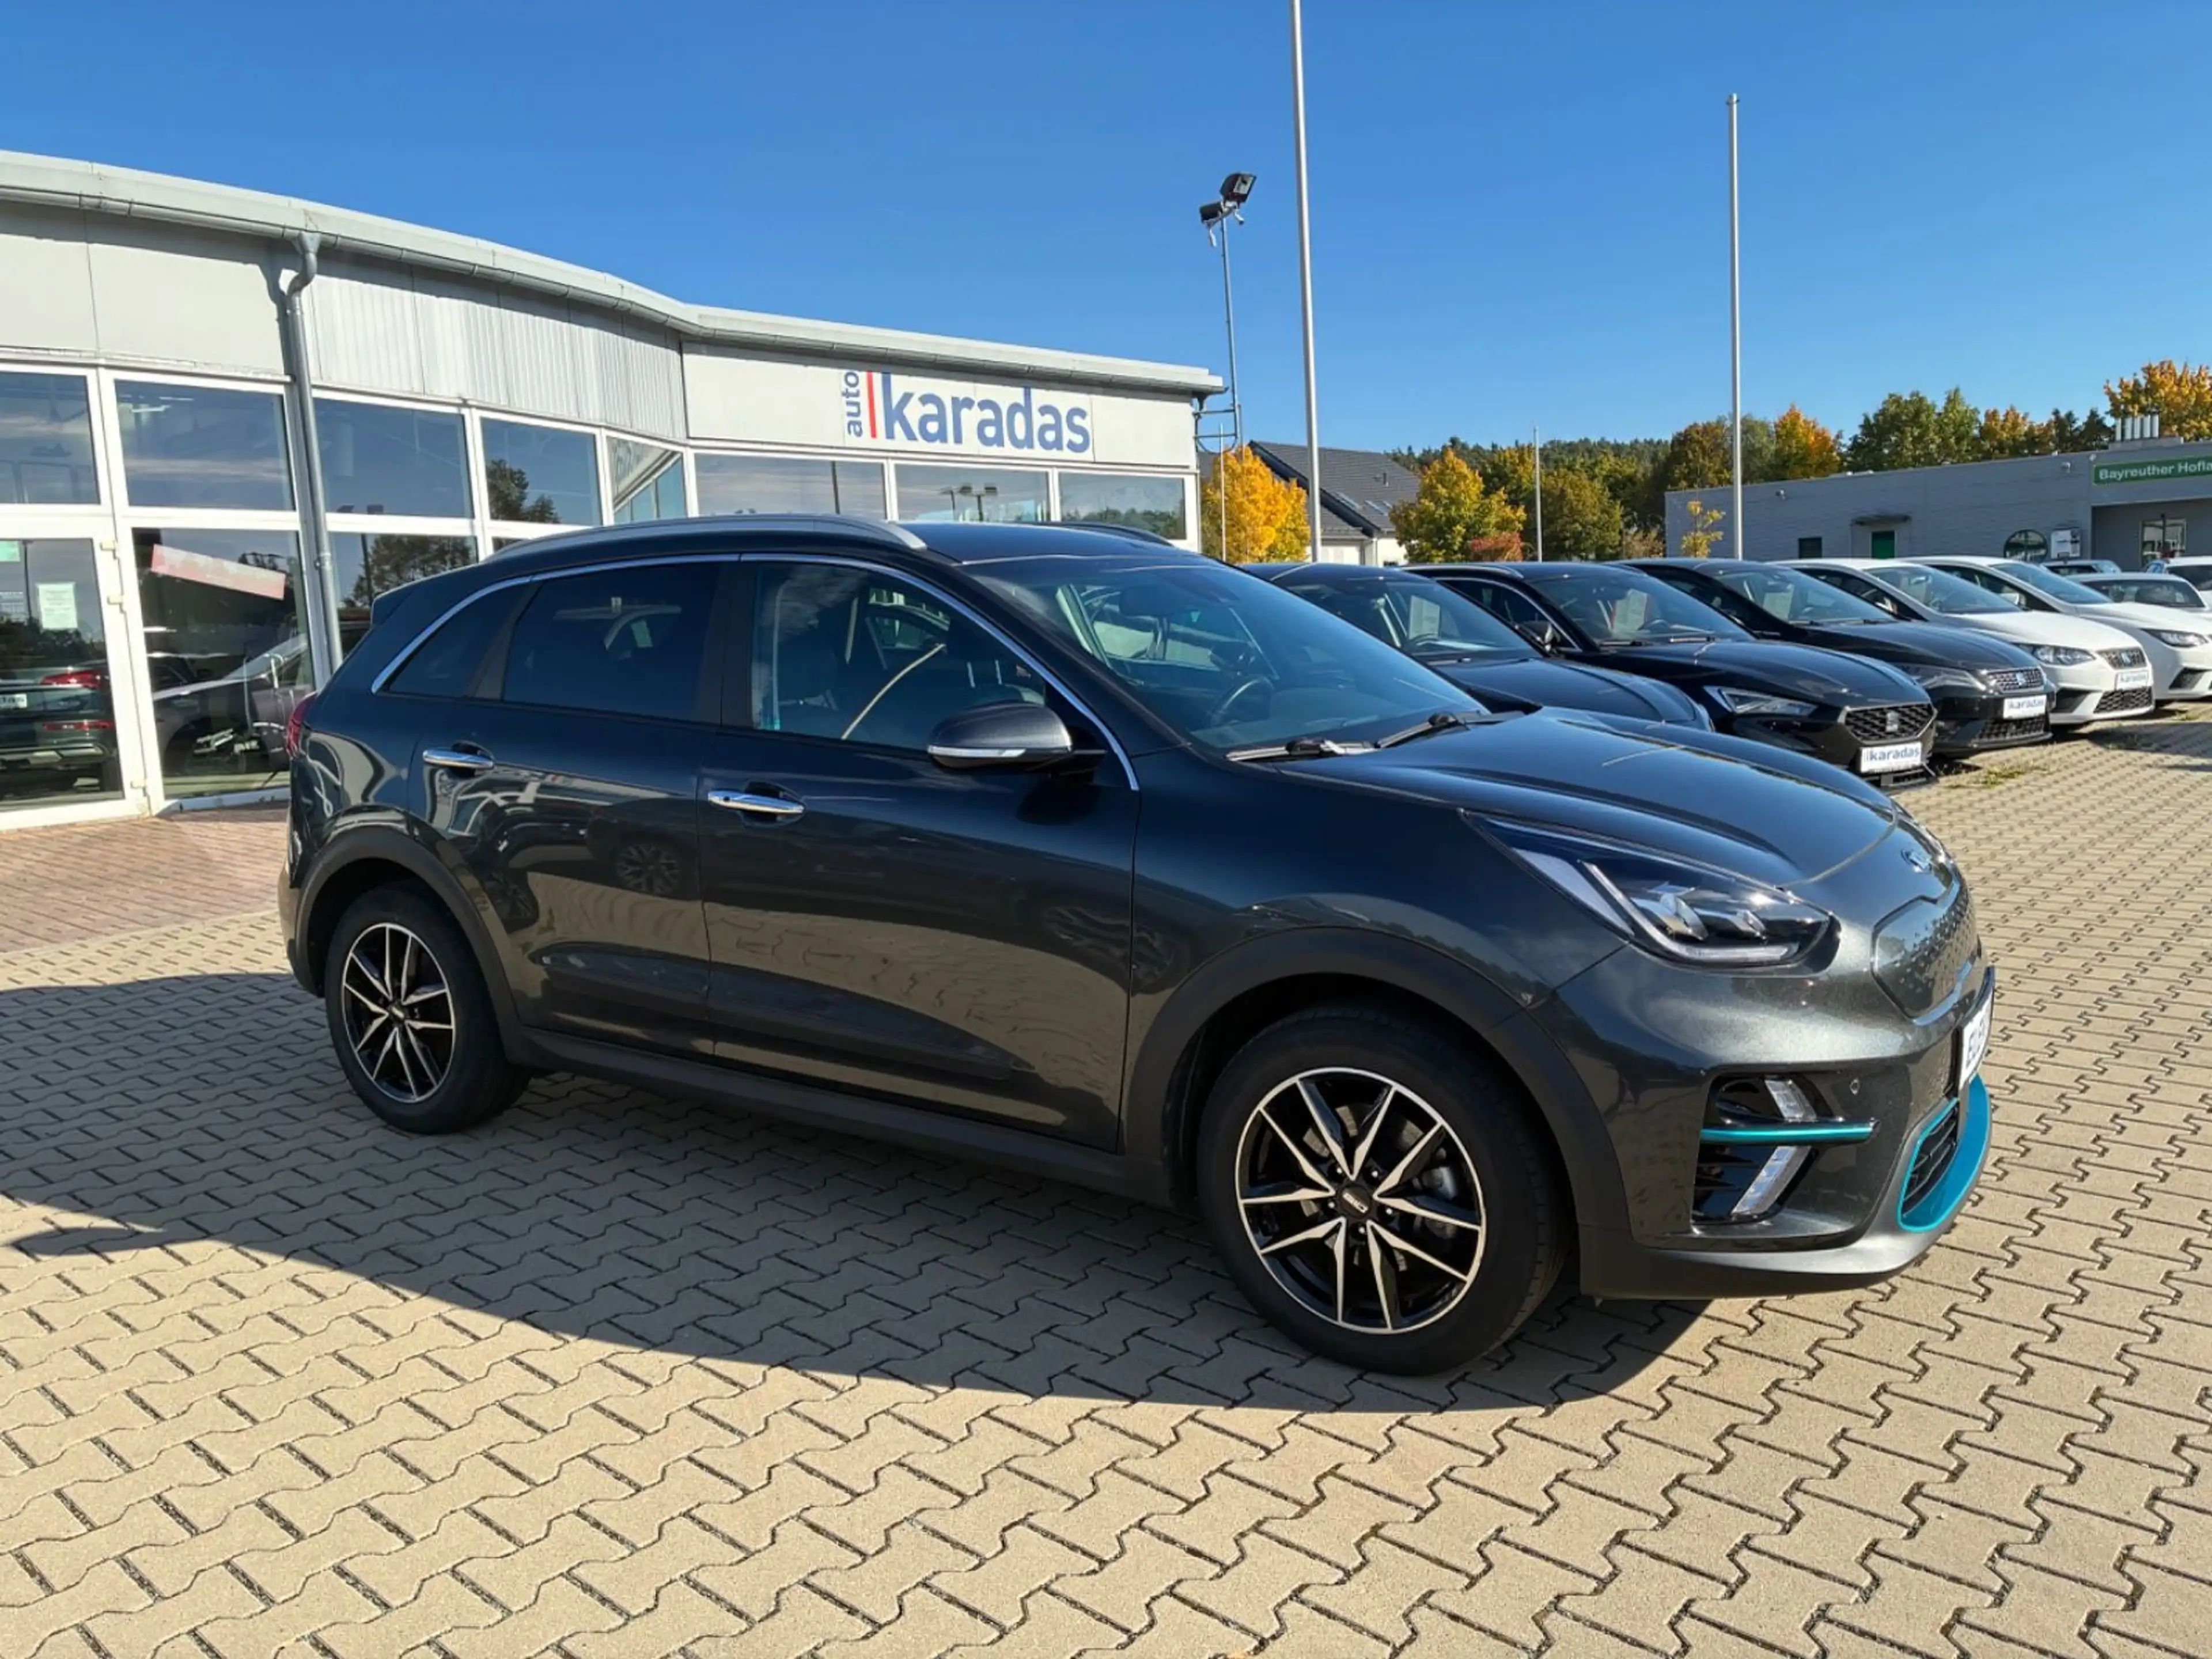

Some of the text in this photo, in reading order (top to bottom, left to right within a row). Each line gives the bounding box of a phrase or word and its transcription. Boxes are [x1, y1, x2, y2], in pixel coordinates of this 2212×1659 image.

[842, 372, 863, 438] auto
[881, 372, 1090, 453] karadas
[2099, 465, 2175, 481] Bayreuther
[1870, 747, 1919, 760] karadas
